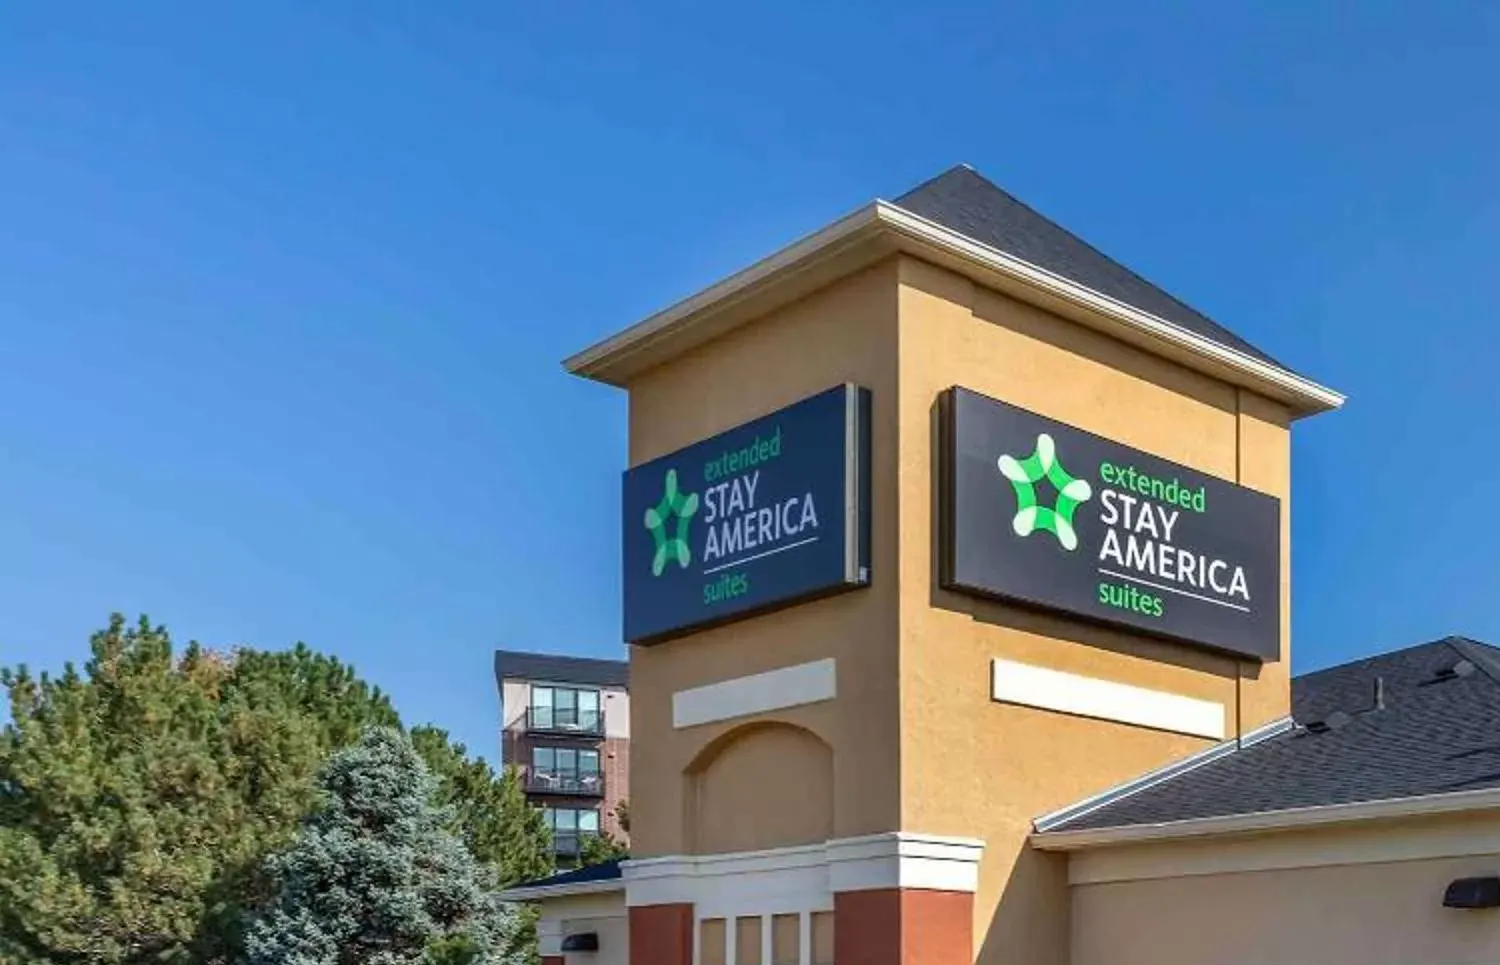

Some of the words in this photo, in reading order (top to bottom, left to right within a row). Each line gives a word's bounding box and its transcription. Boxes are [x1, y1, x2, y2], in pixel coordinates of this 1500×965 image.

[704, 424, 782, 481] extended
[704, 470, 760, 523] STAY
[1100, 460, 1206, 513] extended
[703, 492, 819, 562] AMERICA
[1100, 489, 1180, 542] STAY
[703, 571, 749, 604] suites
[1099, 529, 1251, 601] AMERICA
[1099, 581, 1164, 617] suites
